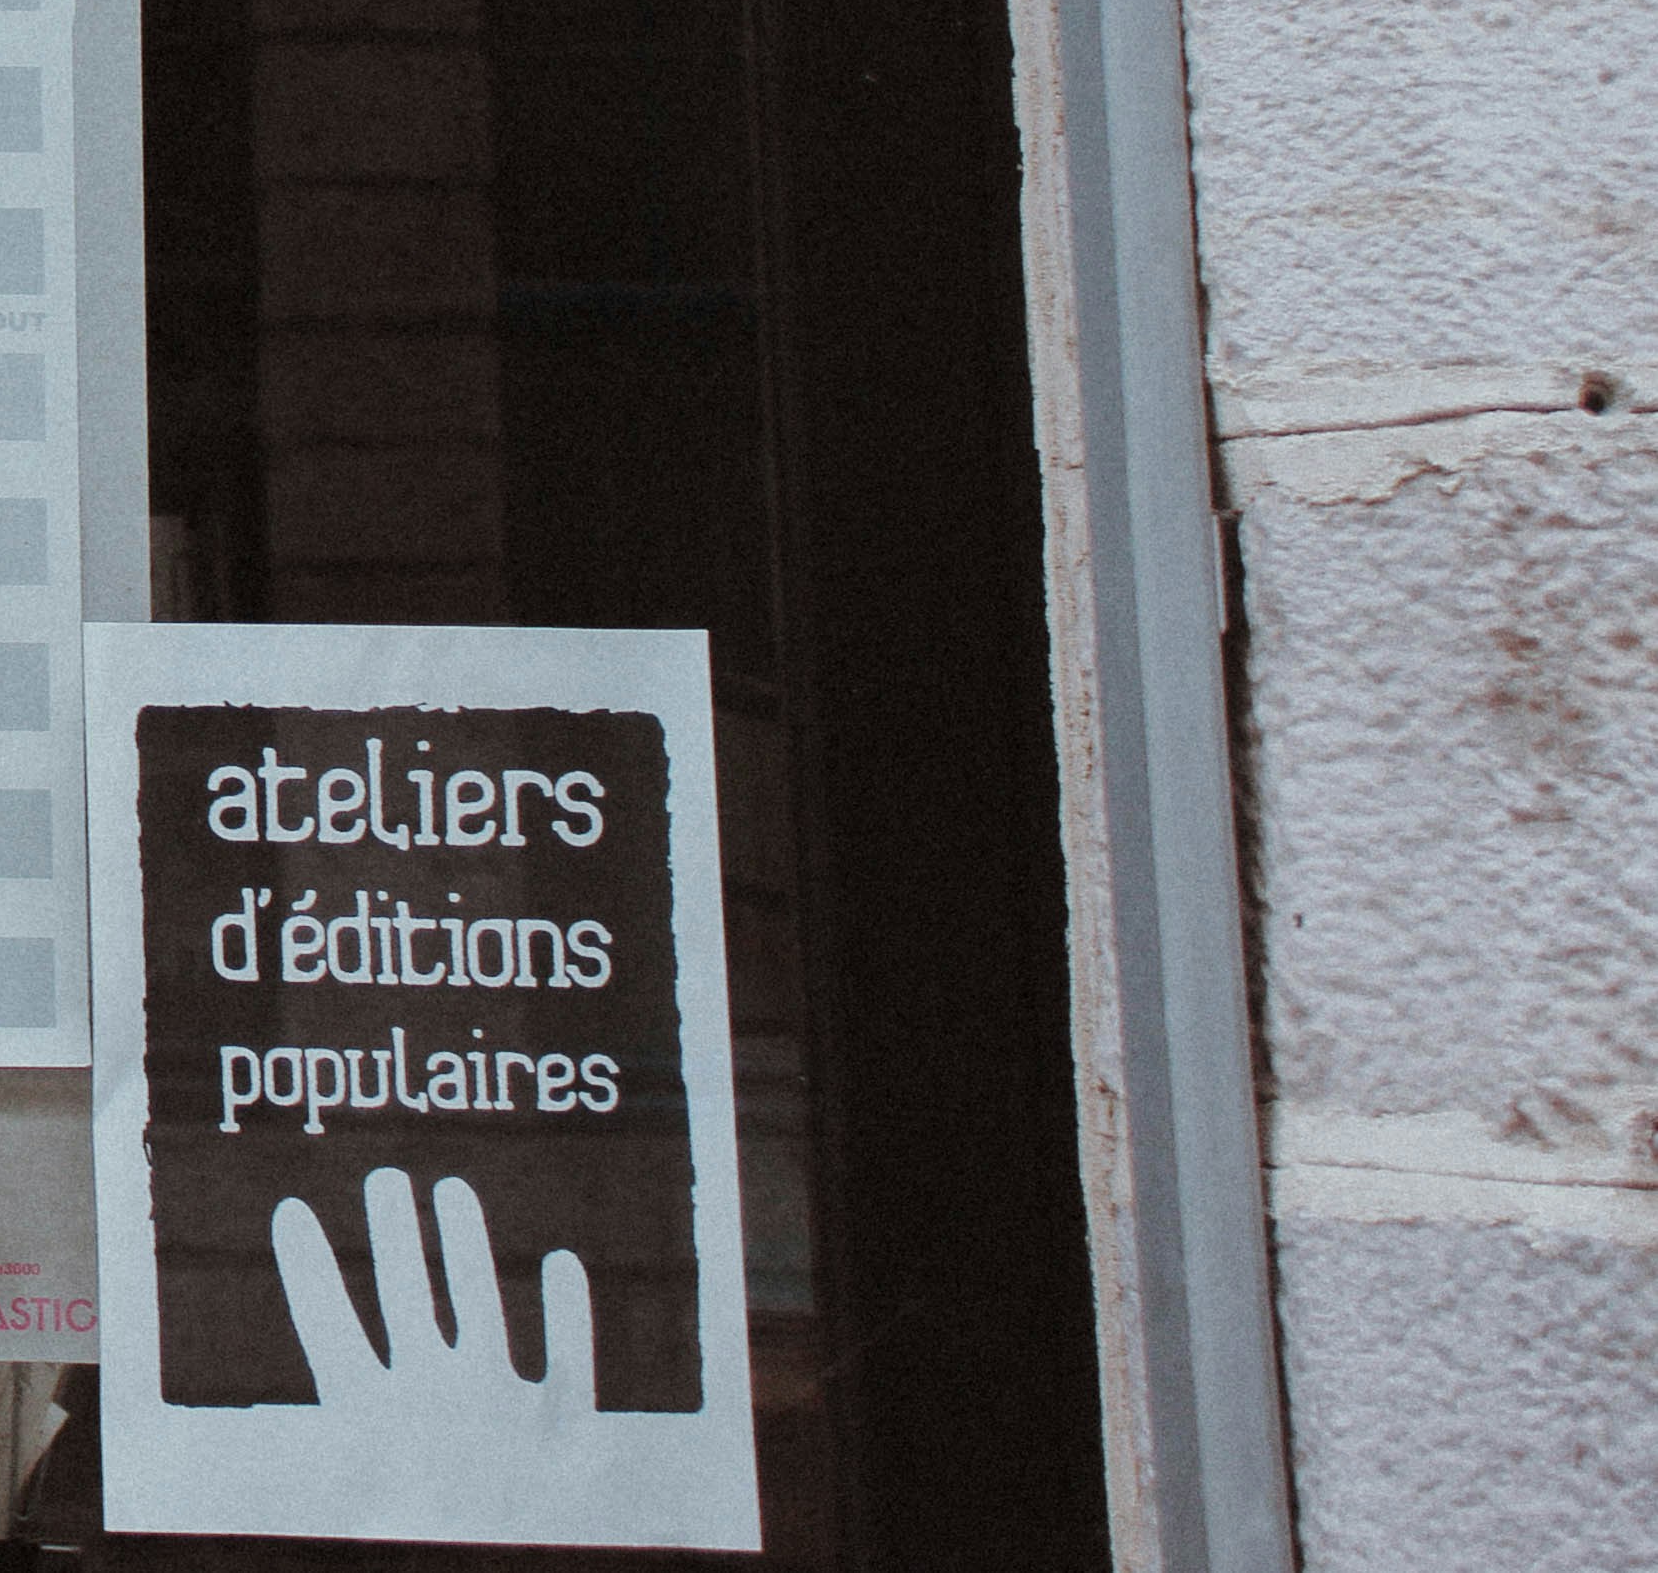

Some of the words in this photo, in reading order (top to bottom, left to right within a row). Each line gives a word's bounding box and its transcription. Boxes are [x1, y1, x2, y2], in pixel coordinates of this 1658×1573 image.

[208, 738, 605, 851] ateliers
[212, 888, 612, 988] d'éditions
[219, 1027, 619, 1134] populaires
